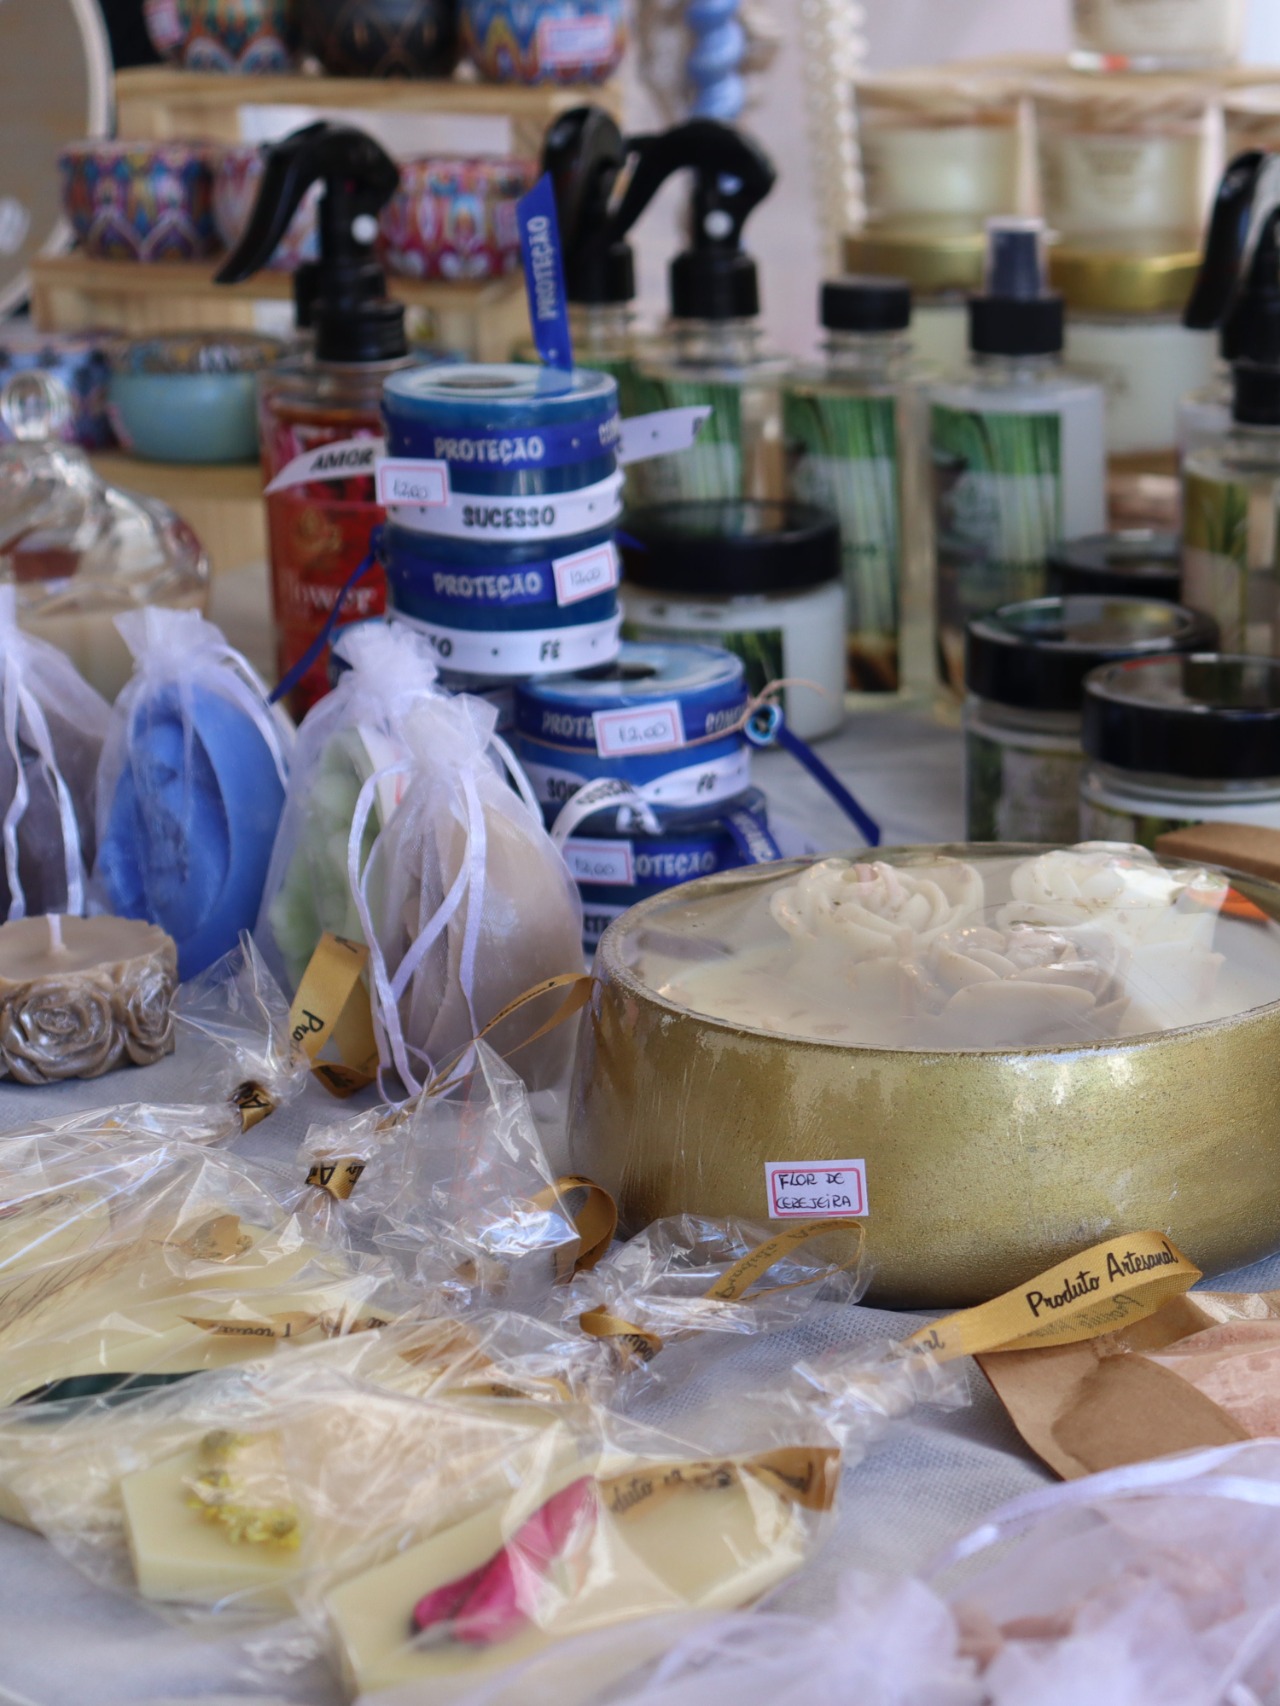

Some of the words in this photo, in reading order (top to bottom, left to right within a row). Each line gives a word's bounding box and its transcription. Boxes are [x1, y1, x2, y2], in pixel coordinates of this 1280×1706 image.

[311, 448, 373, 471] AMOR
[434, 436, 544, 465] PROTEÇÃO
[463, 506, 554, 528] SUCESSO
[433, 572, 542, 600] PROTEÇÃO
[542, 711, 596, 739] PROTE
[619, 722, 667, 742] 12,00
[634, 851, 715, 877] OTEÇÃO
[778, 1172, 817, 1190] FLOR
[826, 1172, 845, 1184] DE
[1026, 1271, 1099, 1317] Produto
[1106, 1240, 1179, 1282] Artesanal
